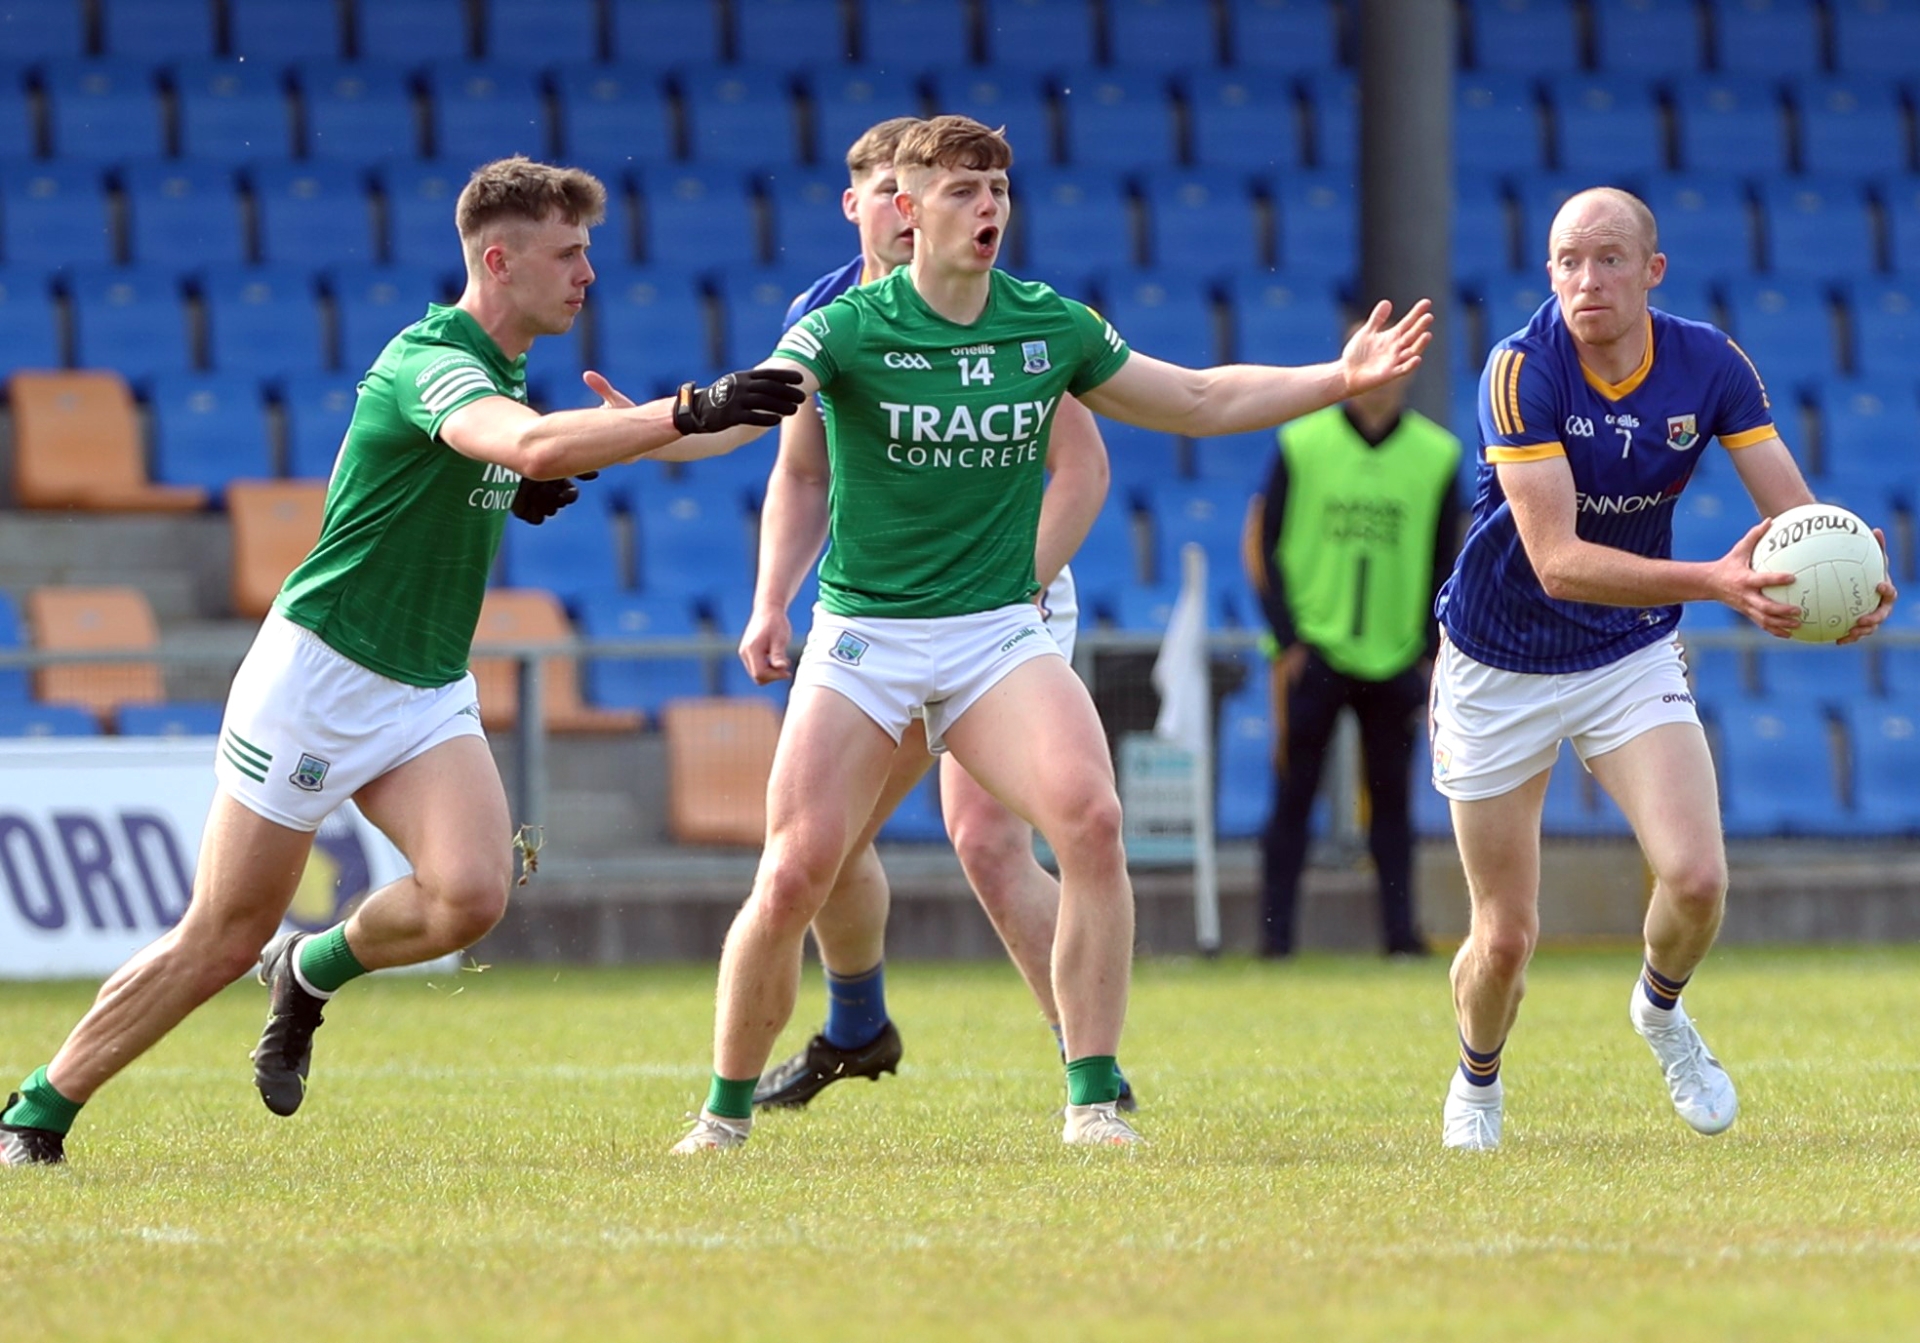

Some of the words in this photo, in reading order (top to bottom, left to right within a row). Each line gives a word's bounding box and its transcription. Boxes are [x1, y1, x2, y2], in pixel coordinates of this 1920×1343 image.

[957, 357, 994, 386] 14
[879, 396, 1056, 442] TRACEY
[887, 439, 1038, 468] CONCRETE
[1615, 428, 1632, 459] 7
